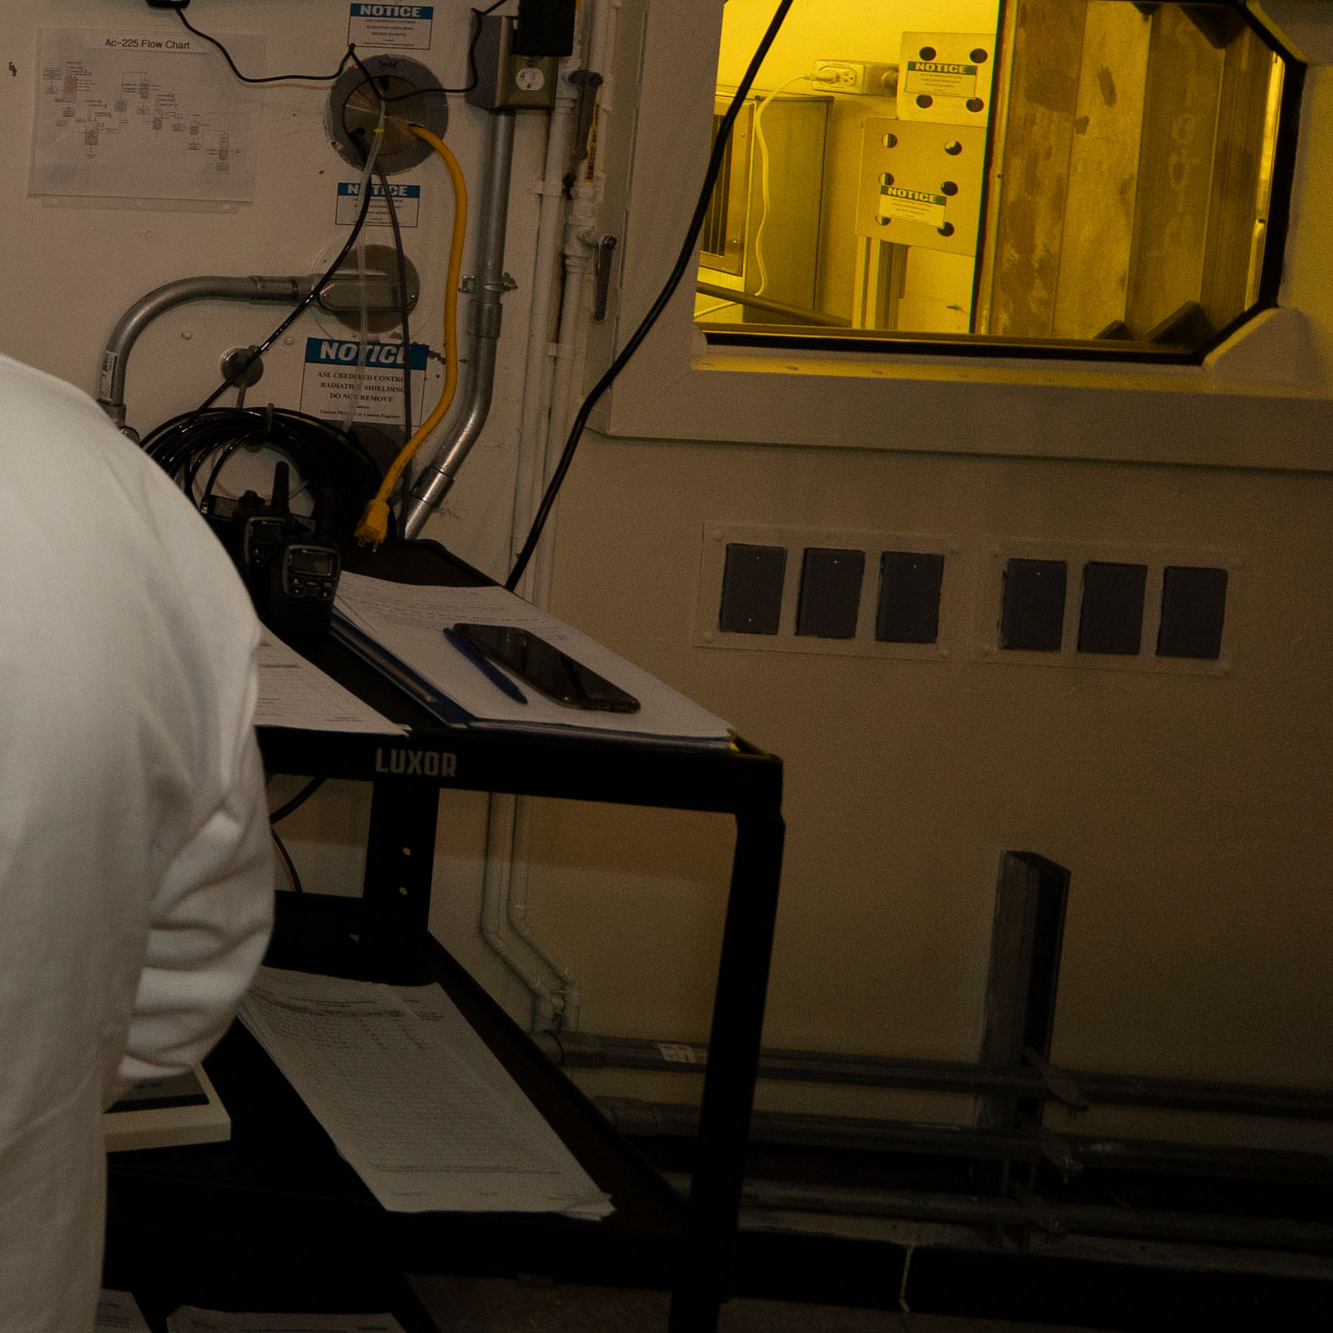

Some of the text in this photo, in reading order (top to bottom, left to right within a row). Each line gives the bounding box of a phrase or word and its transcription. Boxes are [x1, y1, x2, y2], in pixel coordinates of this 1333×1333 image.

[359, 5, 422, 18] NOTICE
[105, 38, 190, 50] Ac-225 Flow Chart
[914, 62, 966, 74] NOTICE
[887, 187, 937, 204] NOTICE
[360, 394, 393, 402] REMOVE
[375, 747, 457, 778] LUXOR
